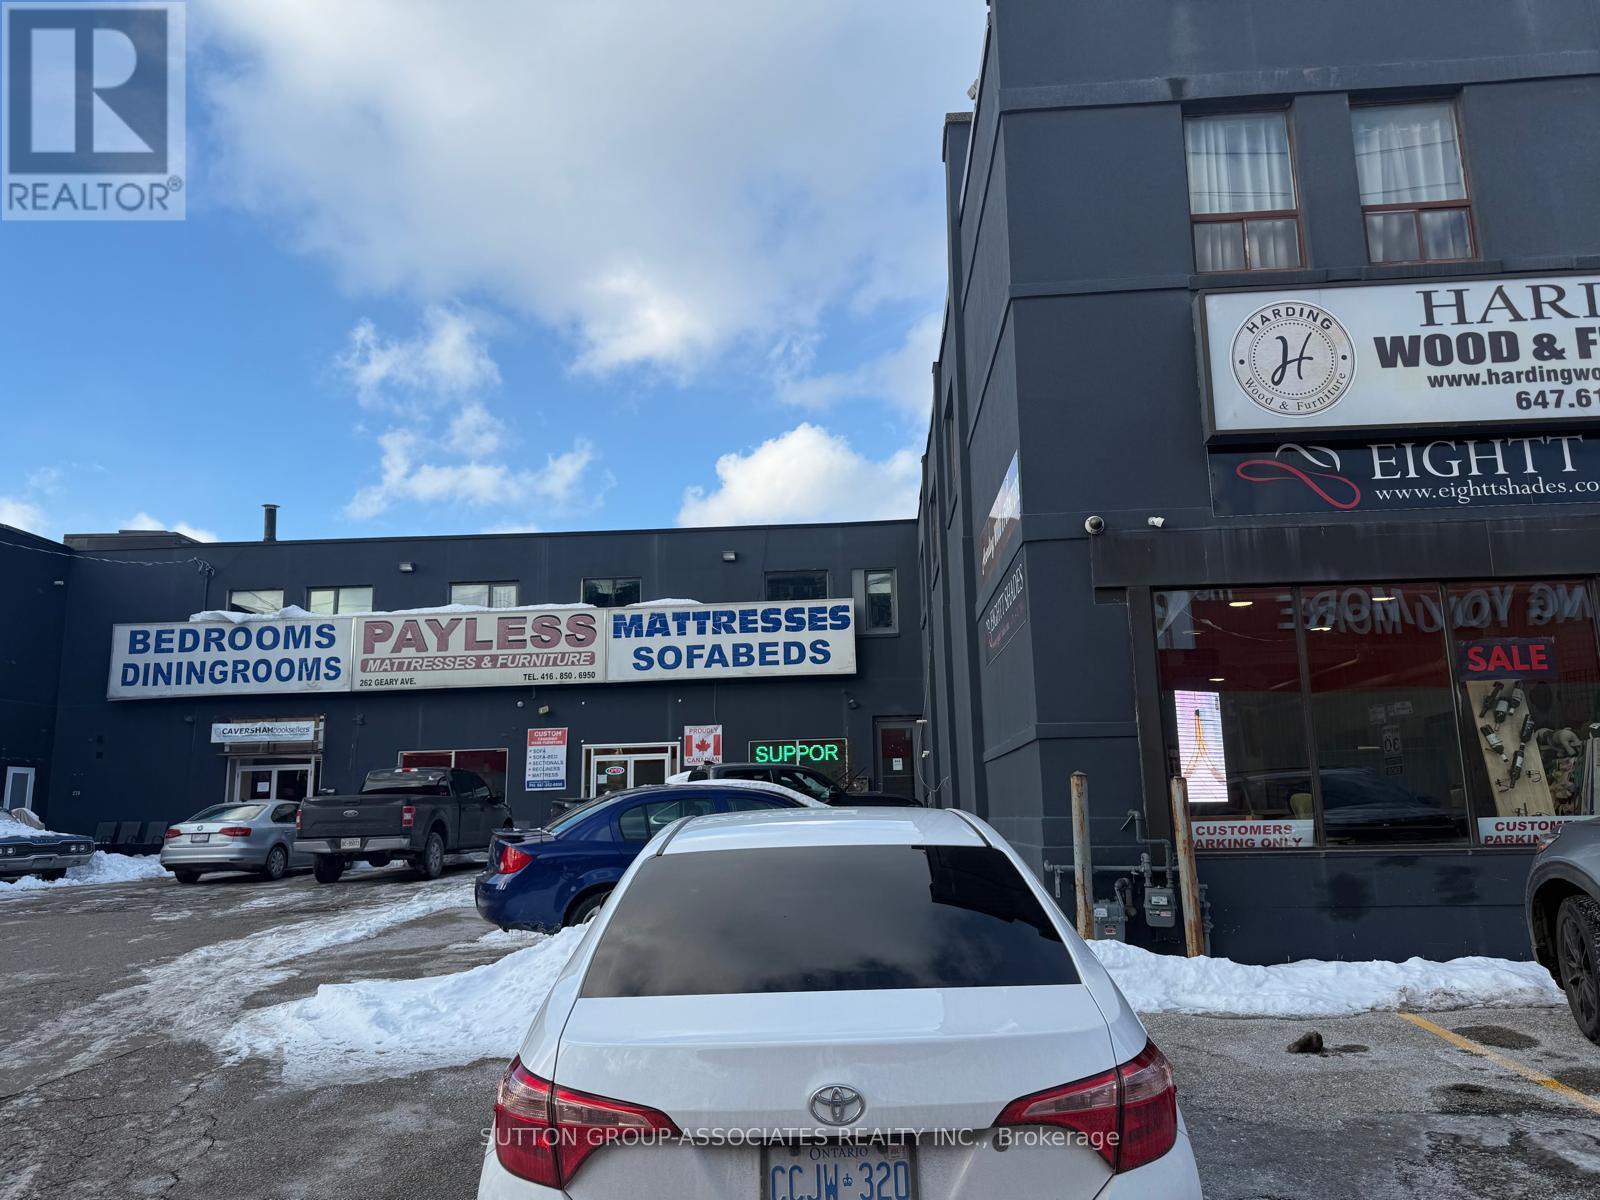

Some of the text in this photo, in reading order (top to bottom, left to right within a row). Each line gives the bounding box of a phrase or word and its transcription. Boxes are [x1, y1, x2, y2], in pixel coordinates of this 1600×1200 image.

[1246, 306, 1333, 335] HARDING
[1373, 330, 1520, 369] WOOD
[1532, 332, 1567, 361] &
[1245, 372, 1346, 410] Wood & Furniture
[1367, 434, 1583, 480] EIGHTT
[363, 613, 597, 654] PAYLESS
[612, 604, 851, 639] MATTRESSES
[129, 624, 336, 655] BEDROOMS
[366, 652, 591, 673] MATTRESSES & FURNITURE
[632, 639, 832, 671] SOFABEDS
[1467, 644, 1549, 672] SALE
[121, 656, 342, 687] DININGROOMS
[360, 677, 417, 687] 262 GEARY AVE.
[523, 673, 539, 681] TEL.
[755, 744, 838, 763] SUPPOR
[1196, 824, 1293, 836] CUSTOMERS
[1260, 837, 1303, 848] ONLY
[809, 1147, 868, 1160] ONTARIO
[771, 1160, 909, 1200] CCJW 320
